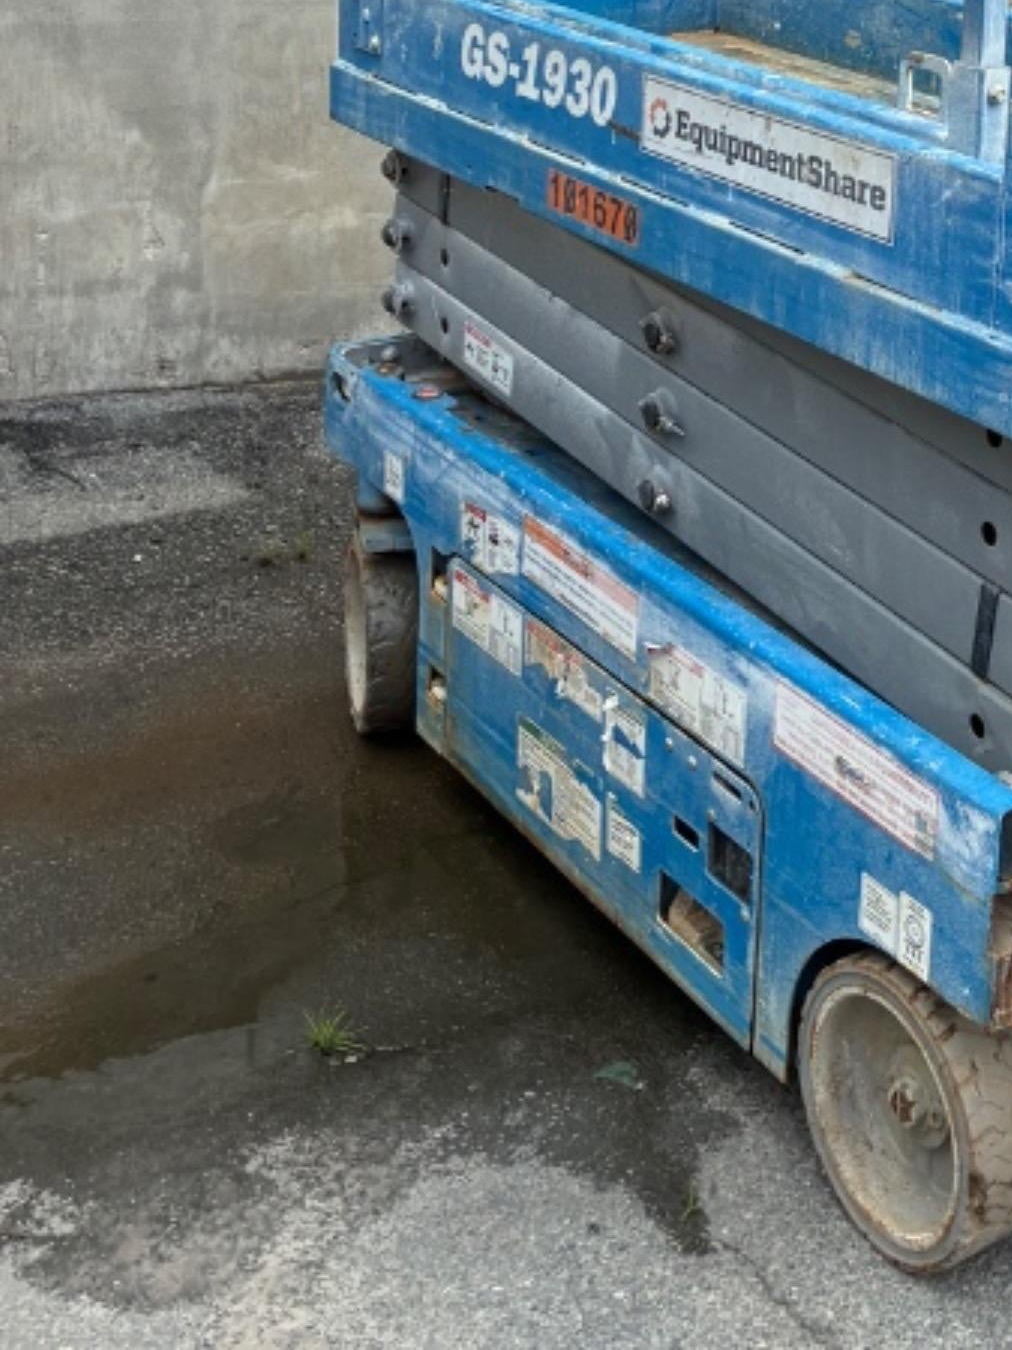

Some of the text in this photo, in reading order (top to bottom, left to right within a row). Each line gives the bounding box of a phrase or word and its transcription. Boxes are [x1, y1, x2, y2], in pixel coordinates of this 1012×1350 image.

[461, 23, 618, 127] GS-1930
[550, 172, 638, 244] 101670
[674, 109, 887, 212] EquipmentShare
